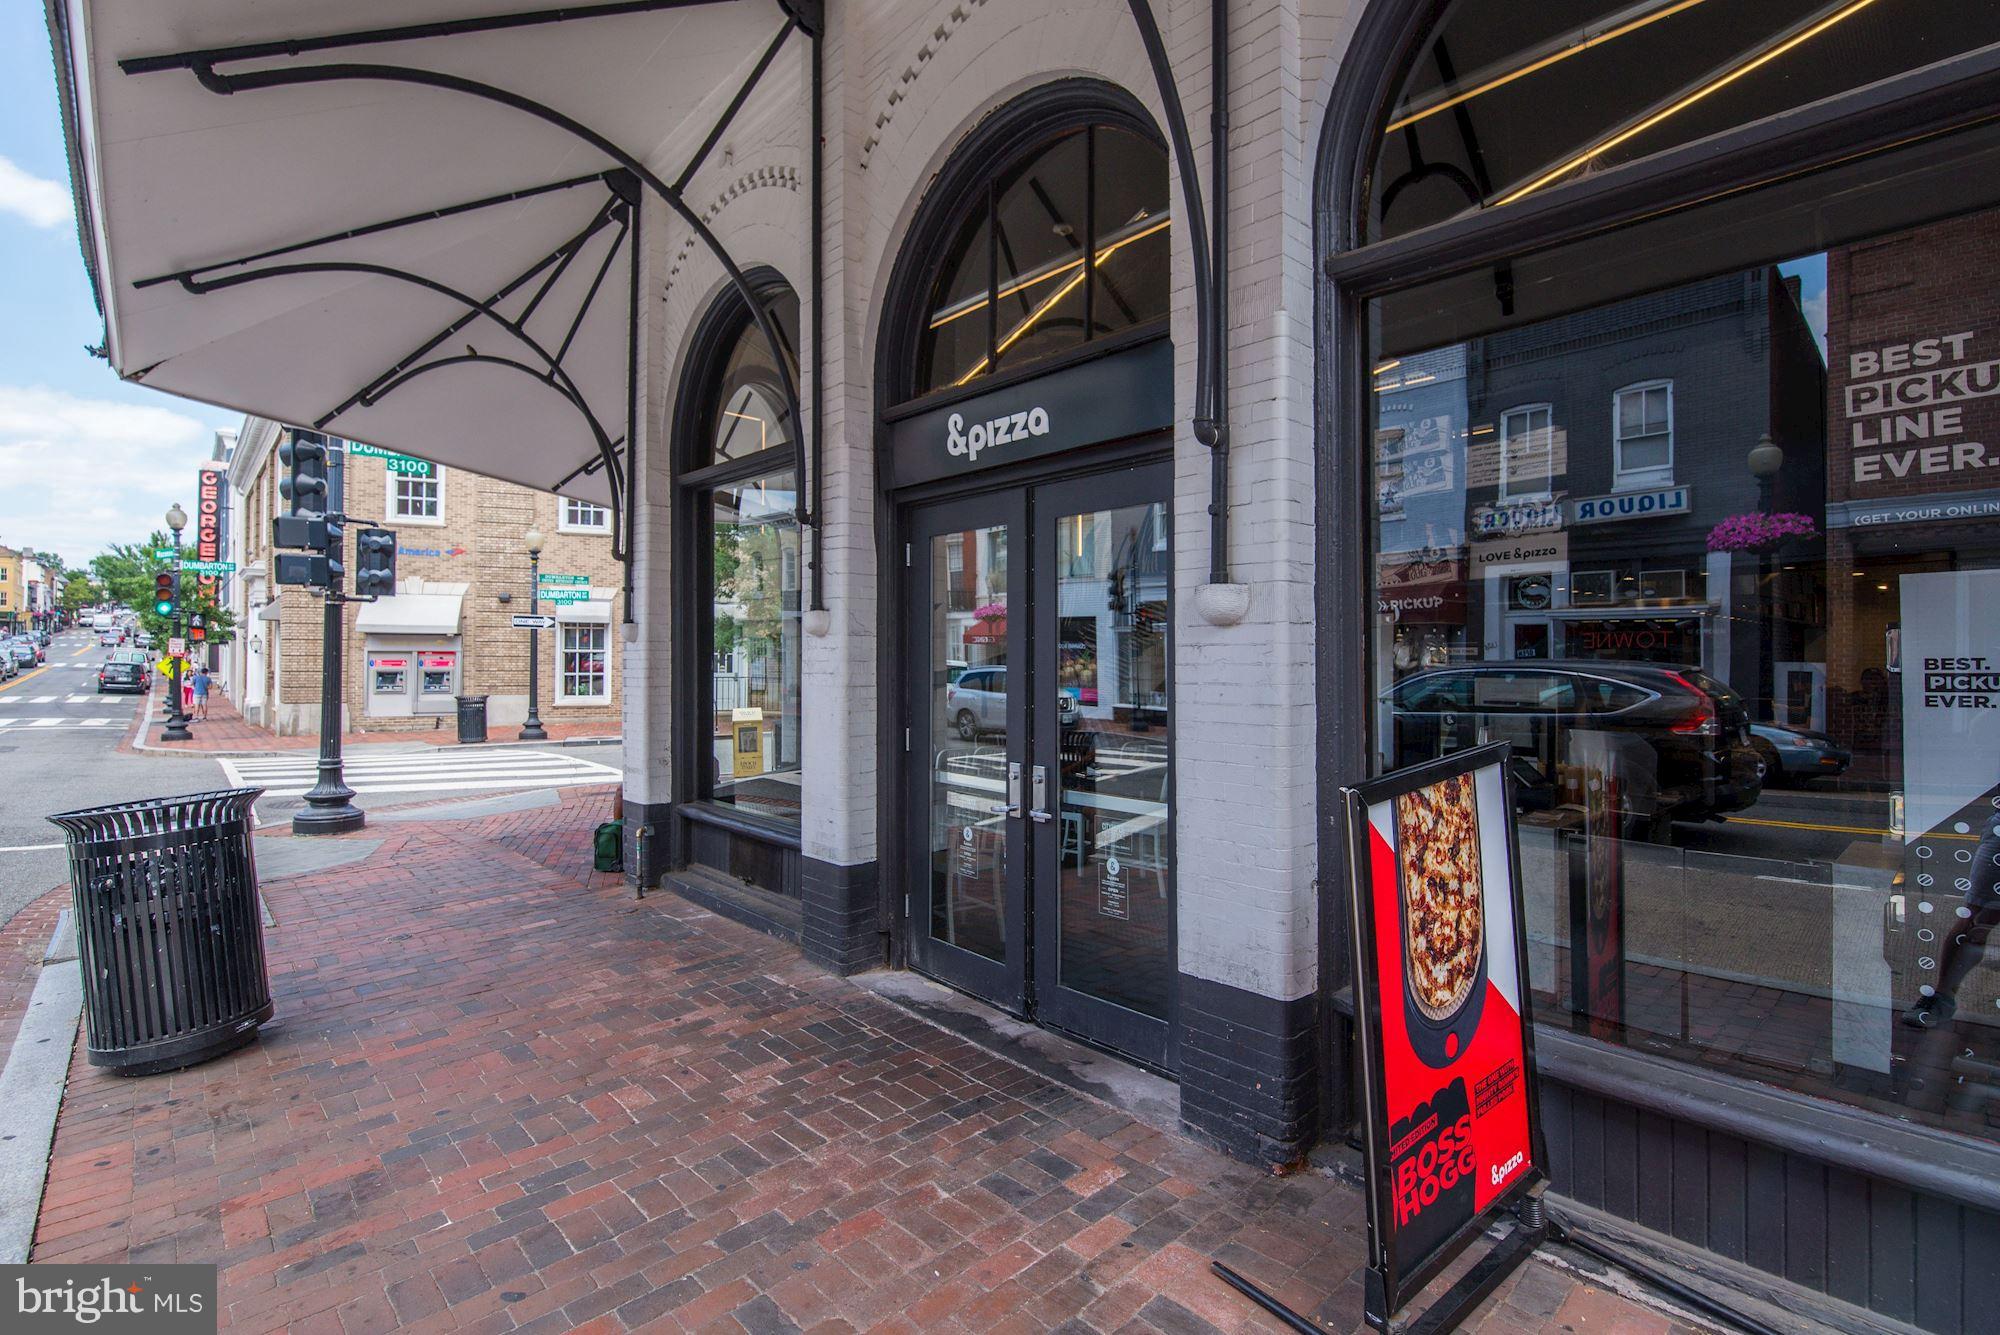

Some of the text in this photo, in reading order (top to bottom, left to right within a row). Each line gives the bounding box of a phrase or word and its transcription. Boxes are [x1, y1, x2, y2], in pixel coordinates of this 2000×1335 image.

[1851, 331, 1974, 379] BEST
[946, 406, 1050, 462] &pizza
[1853, 407, 1963, 448] LINE
[388, 458, 428, 473] 3100
[1854, 442, 2000, 482] EVER.
[1855, 513, 1891, 526] (GET
[1896, 508, 1941, 522] YOUR
[1479, 547, 1557, 563] LOVE &pizza
[183, 561, 228, 571] DUMBARTON
[540, 590, 581, 600] DUMBARTON
[1390, 595, 1444, 611] PICKUP
[1924, 657, 1991, 671] BEST.
[1924, 695, 1997, 709] EVER.
[1398, 1114, 1471, 1199] BOSS
[1491, 1151, 1523, 1185] &pizza
[1399, 1145, 1477, 1226] HOGG
